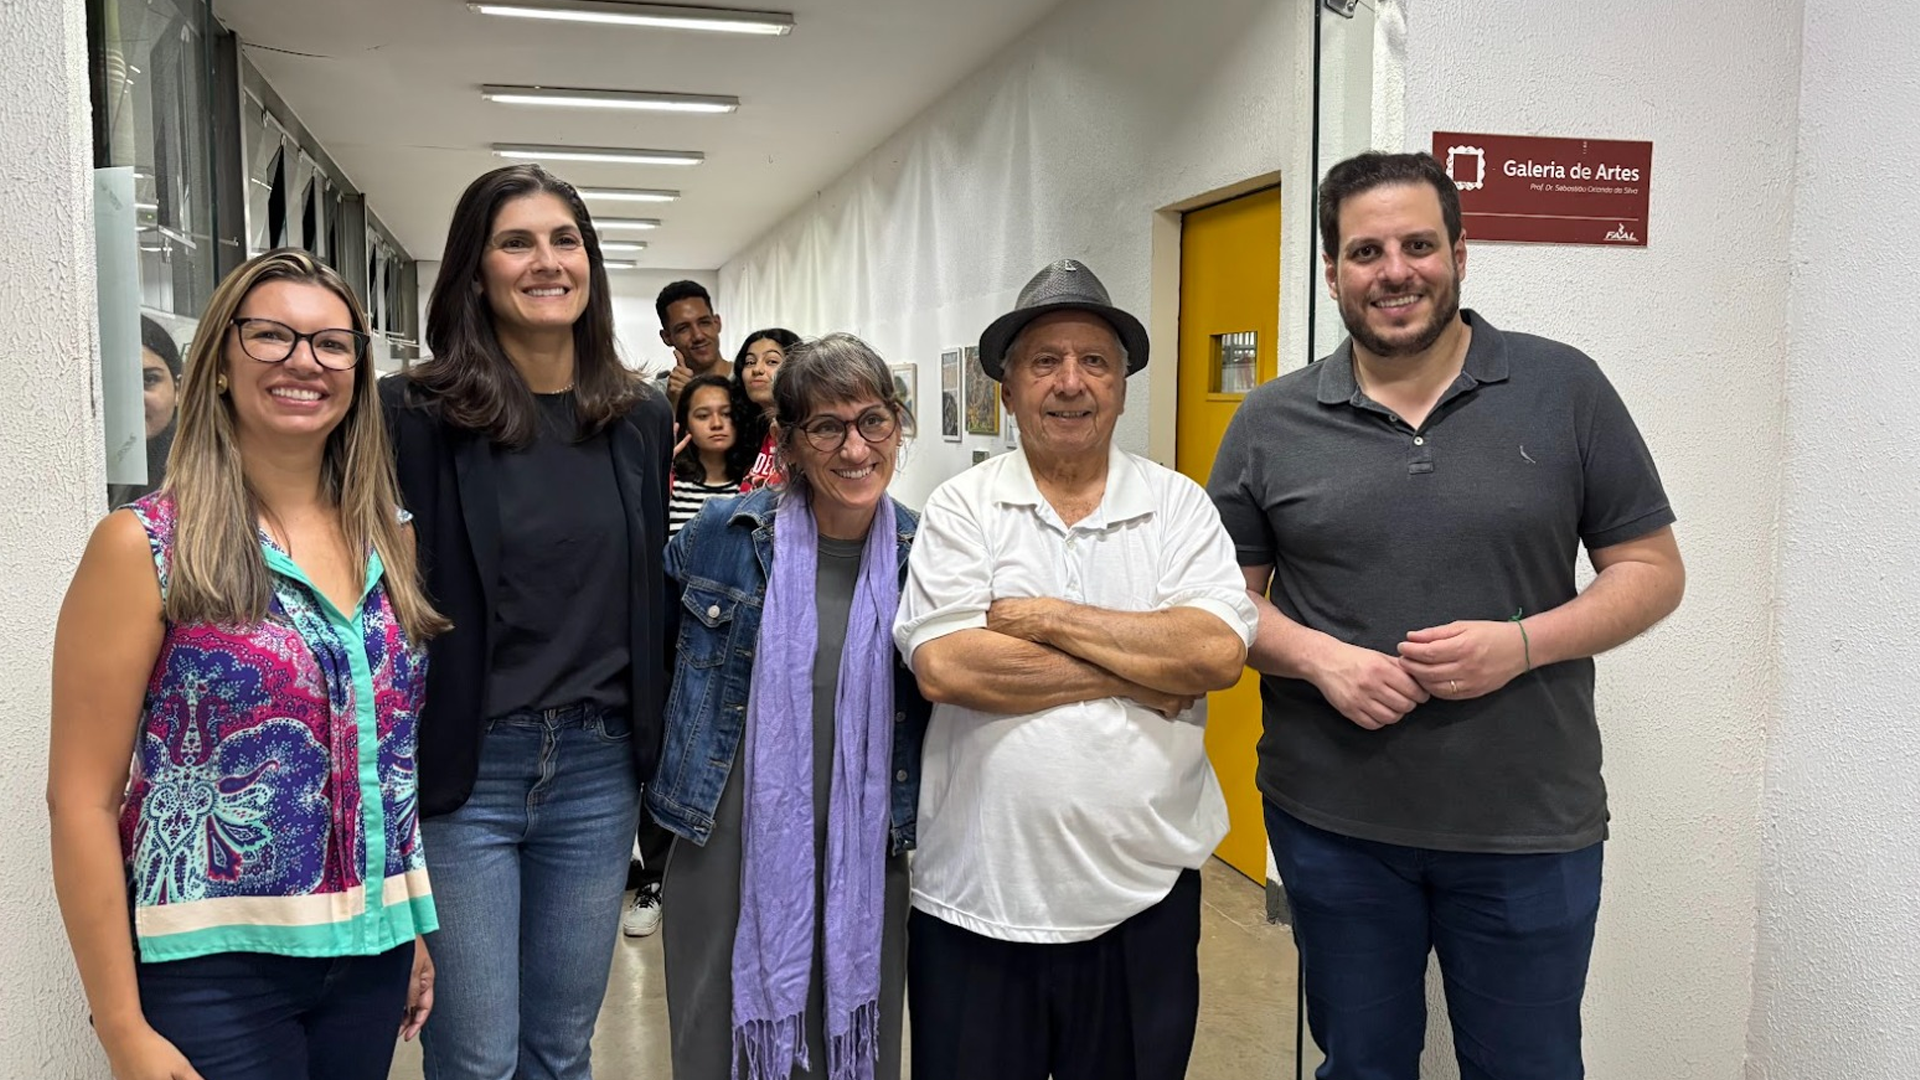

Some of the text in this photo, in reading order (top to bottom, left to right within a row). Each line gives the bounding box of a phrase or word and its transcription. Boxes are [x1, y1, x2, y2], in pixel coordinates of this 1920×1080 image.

[1503, 159, 1640, 182] Galeria de Artes
